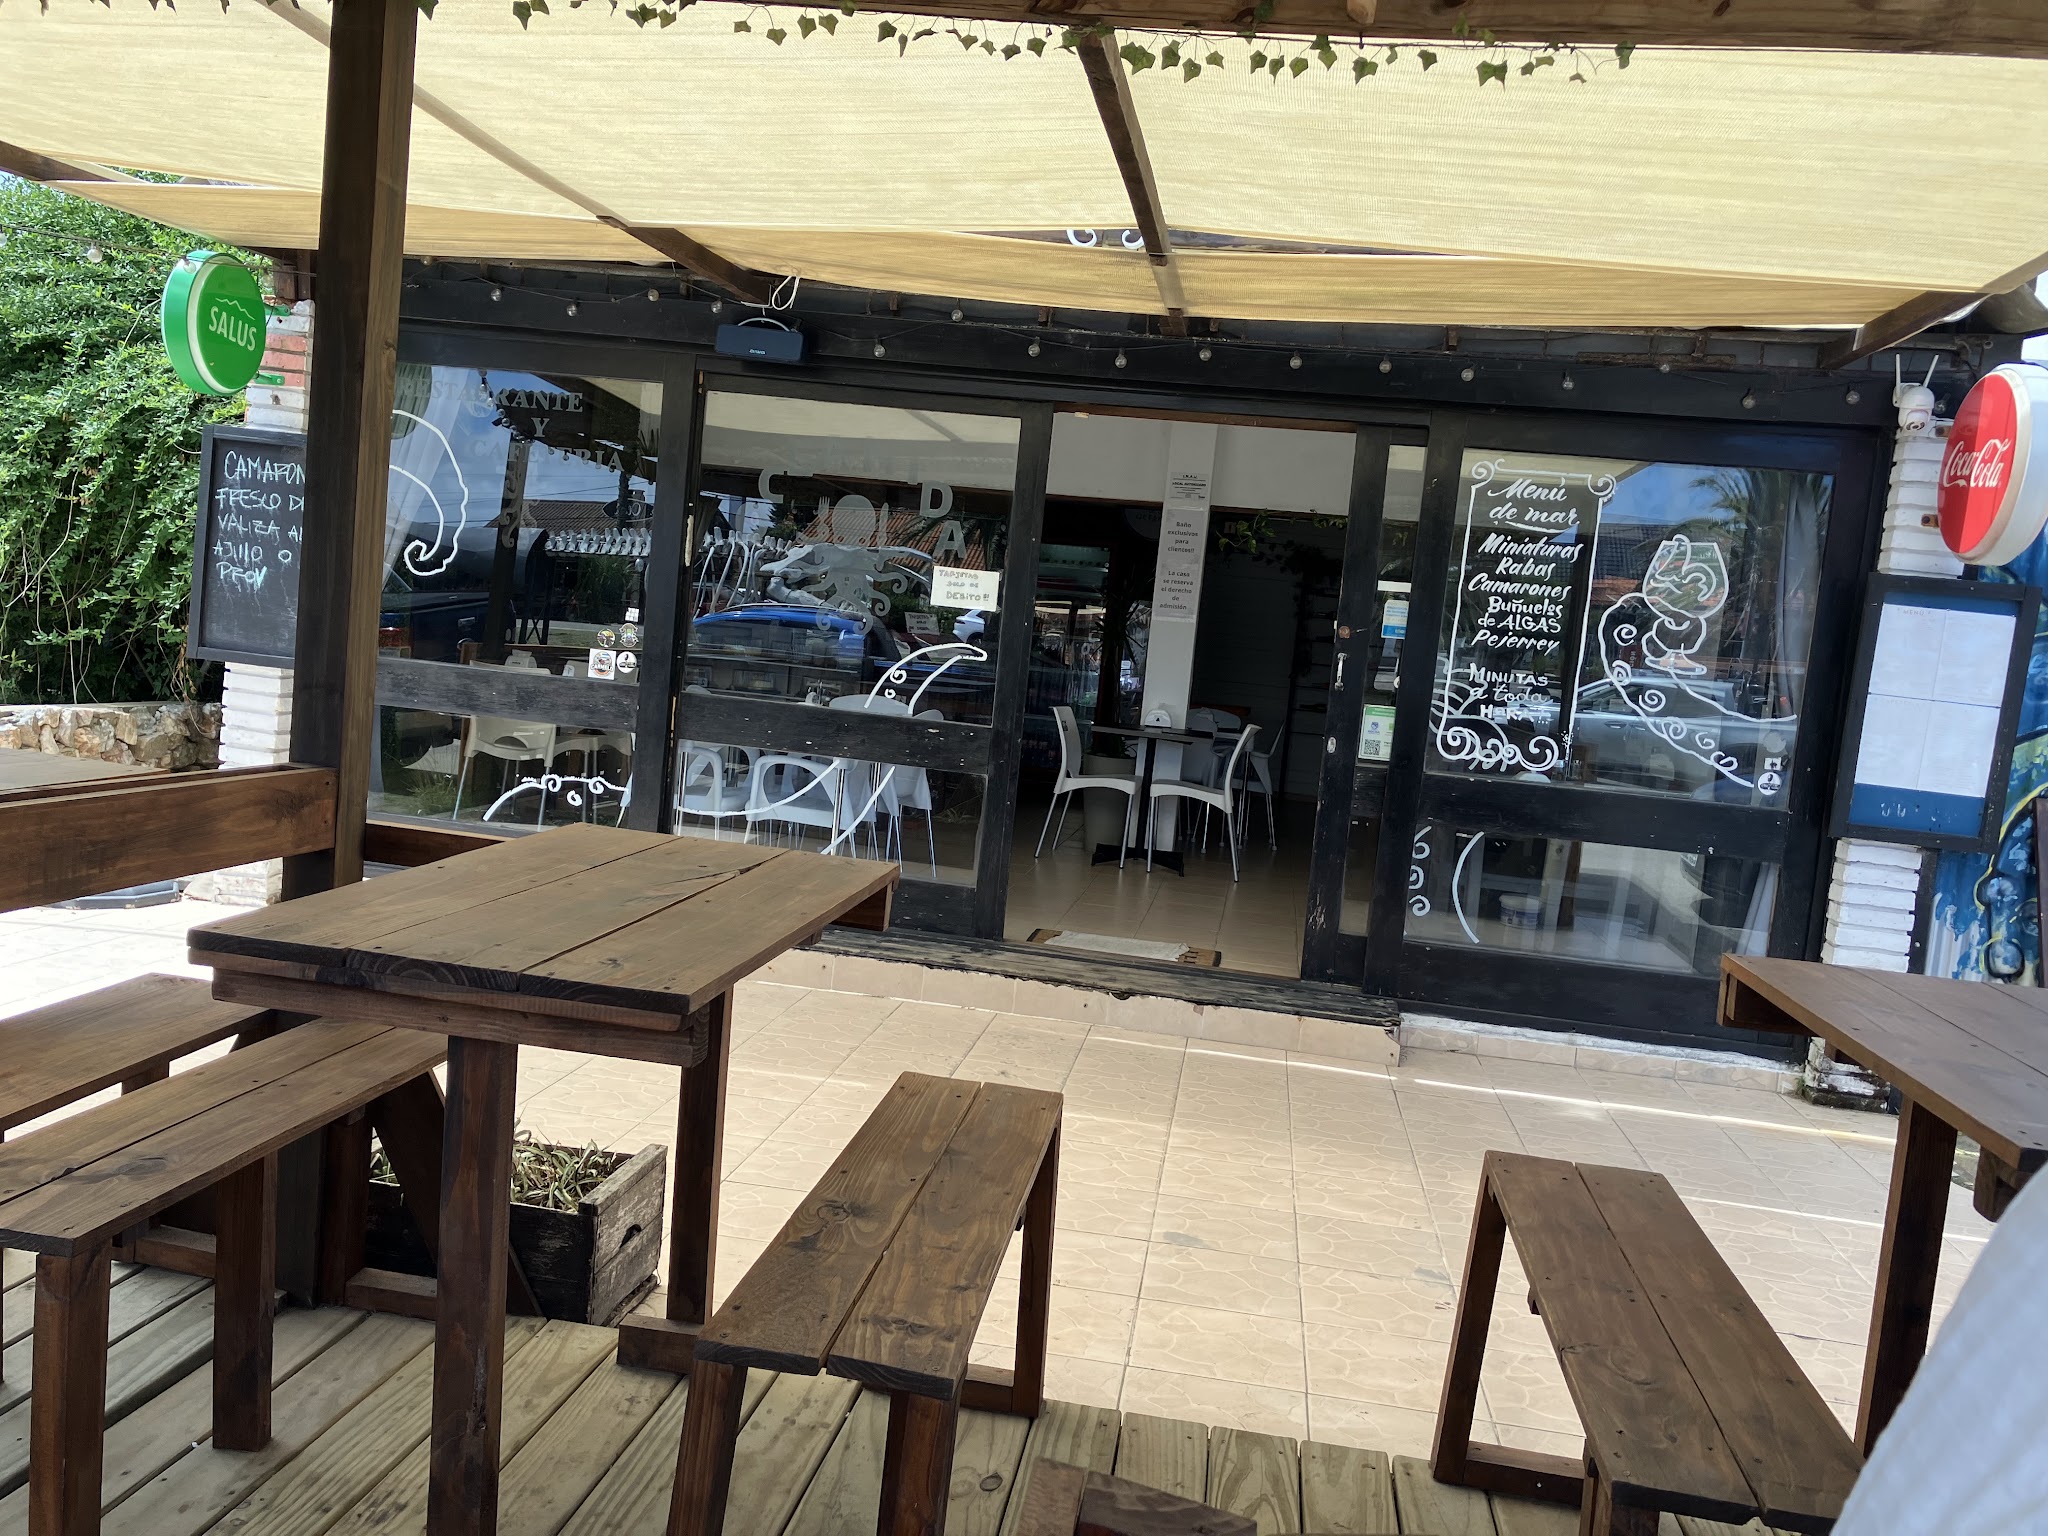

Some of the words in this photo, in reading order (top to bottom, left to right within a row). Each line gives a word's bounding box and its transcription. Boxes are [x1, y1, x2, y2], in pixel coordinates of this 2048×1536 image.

[208, 305, 258, 352] SALUS
[531, 416, 551, 438] Y
[1943, 438, 2012, 488] Coca-Cola
[214, 487, 281, 510] FRESCO
[1487, 477, 1568, 501] Menú
[1489, 502, 1518, 520] de
[1524, 507, 1580, 526] mar
[217, 512, 280, 546] VALIZA
[1478, 532, 1585, 563] Miniaturas
[1495, 556, 1557, 582] Rabas
[1467, 572, 1573, 602] Camarones
[1487, 596, 1564, 620] Buñuelos
[1477, 612, 1496, 628] de
[1496, 614, 1562, 634] ALGAS
[1471, 629, 1561, 657] Pejerrey
[1469, 662, 1549, 687] MINUTAS
[1492, 683, 1550, 703] toda
